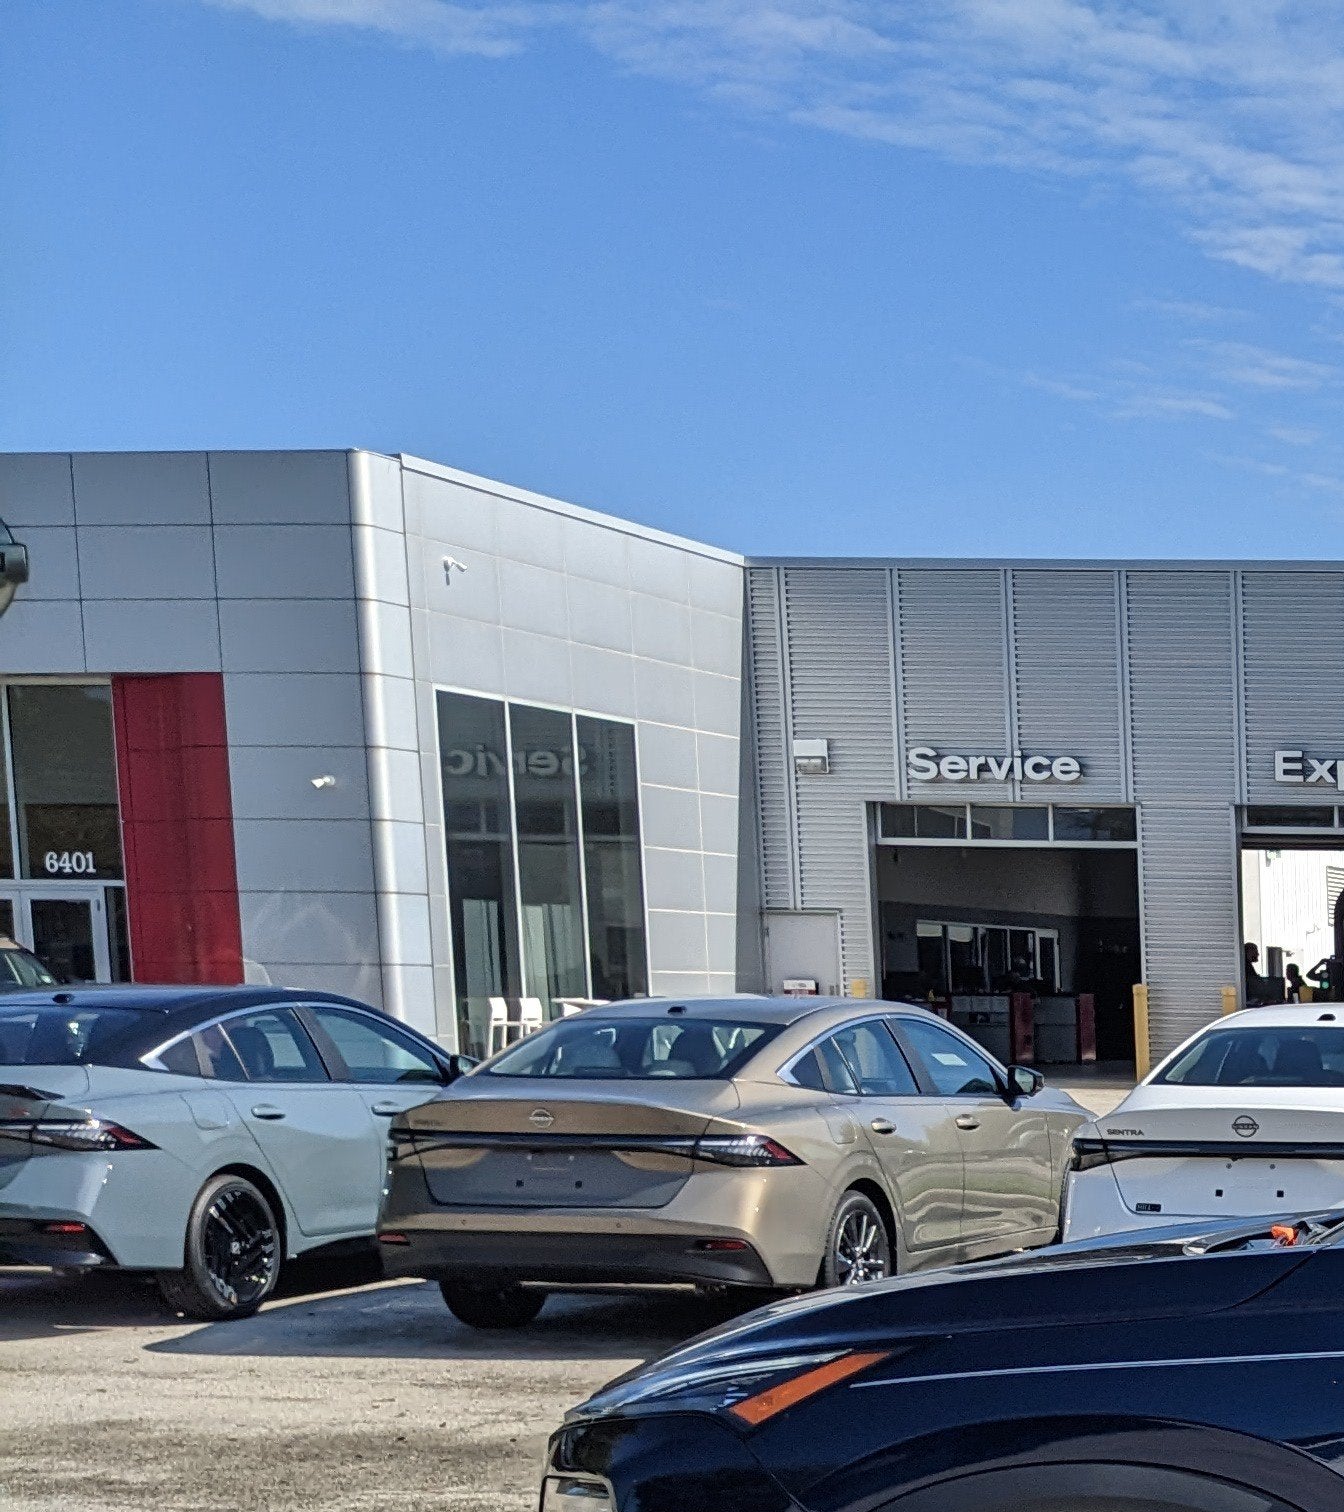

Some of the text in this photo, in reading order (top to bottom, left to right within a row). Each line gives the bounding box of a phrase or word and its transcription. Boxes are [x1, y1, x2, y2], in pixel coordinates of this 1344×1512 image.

[908, 746, 1081, 781] Service
[45, 851, 97, 873] 6401
[1106, 1128, 1145, 1137] SENTRA
